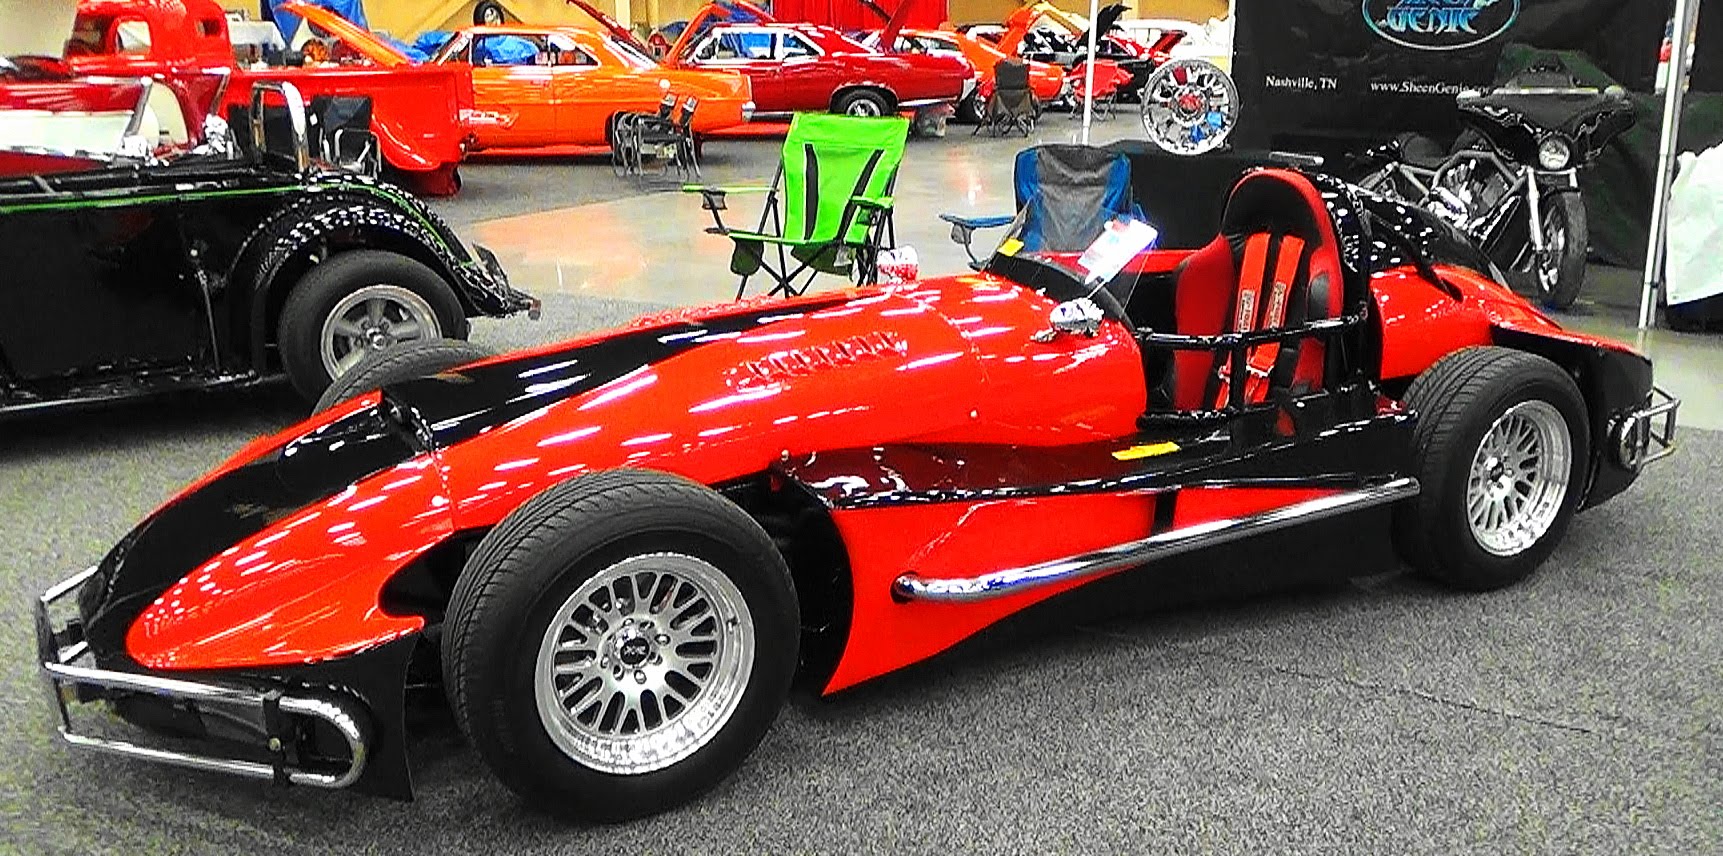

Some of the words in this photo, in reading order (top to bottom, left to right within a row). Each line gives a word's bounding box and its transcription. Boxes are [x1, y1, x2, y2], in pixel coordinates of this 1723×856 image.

[1265, 75, 1318, 90] Nashville,
[1319, 77, 1338, 90] TN
[1370, 80, 1492, 95] www.SheenGenieco
